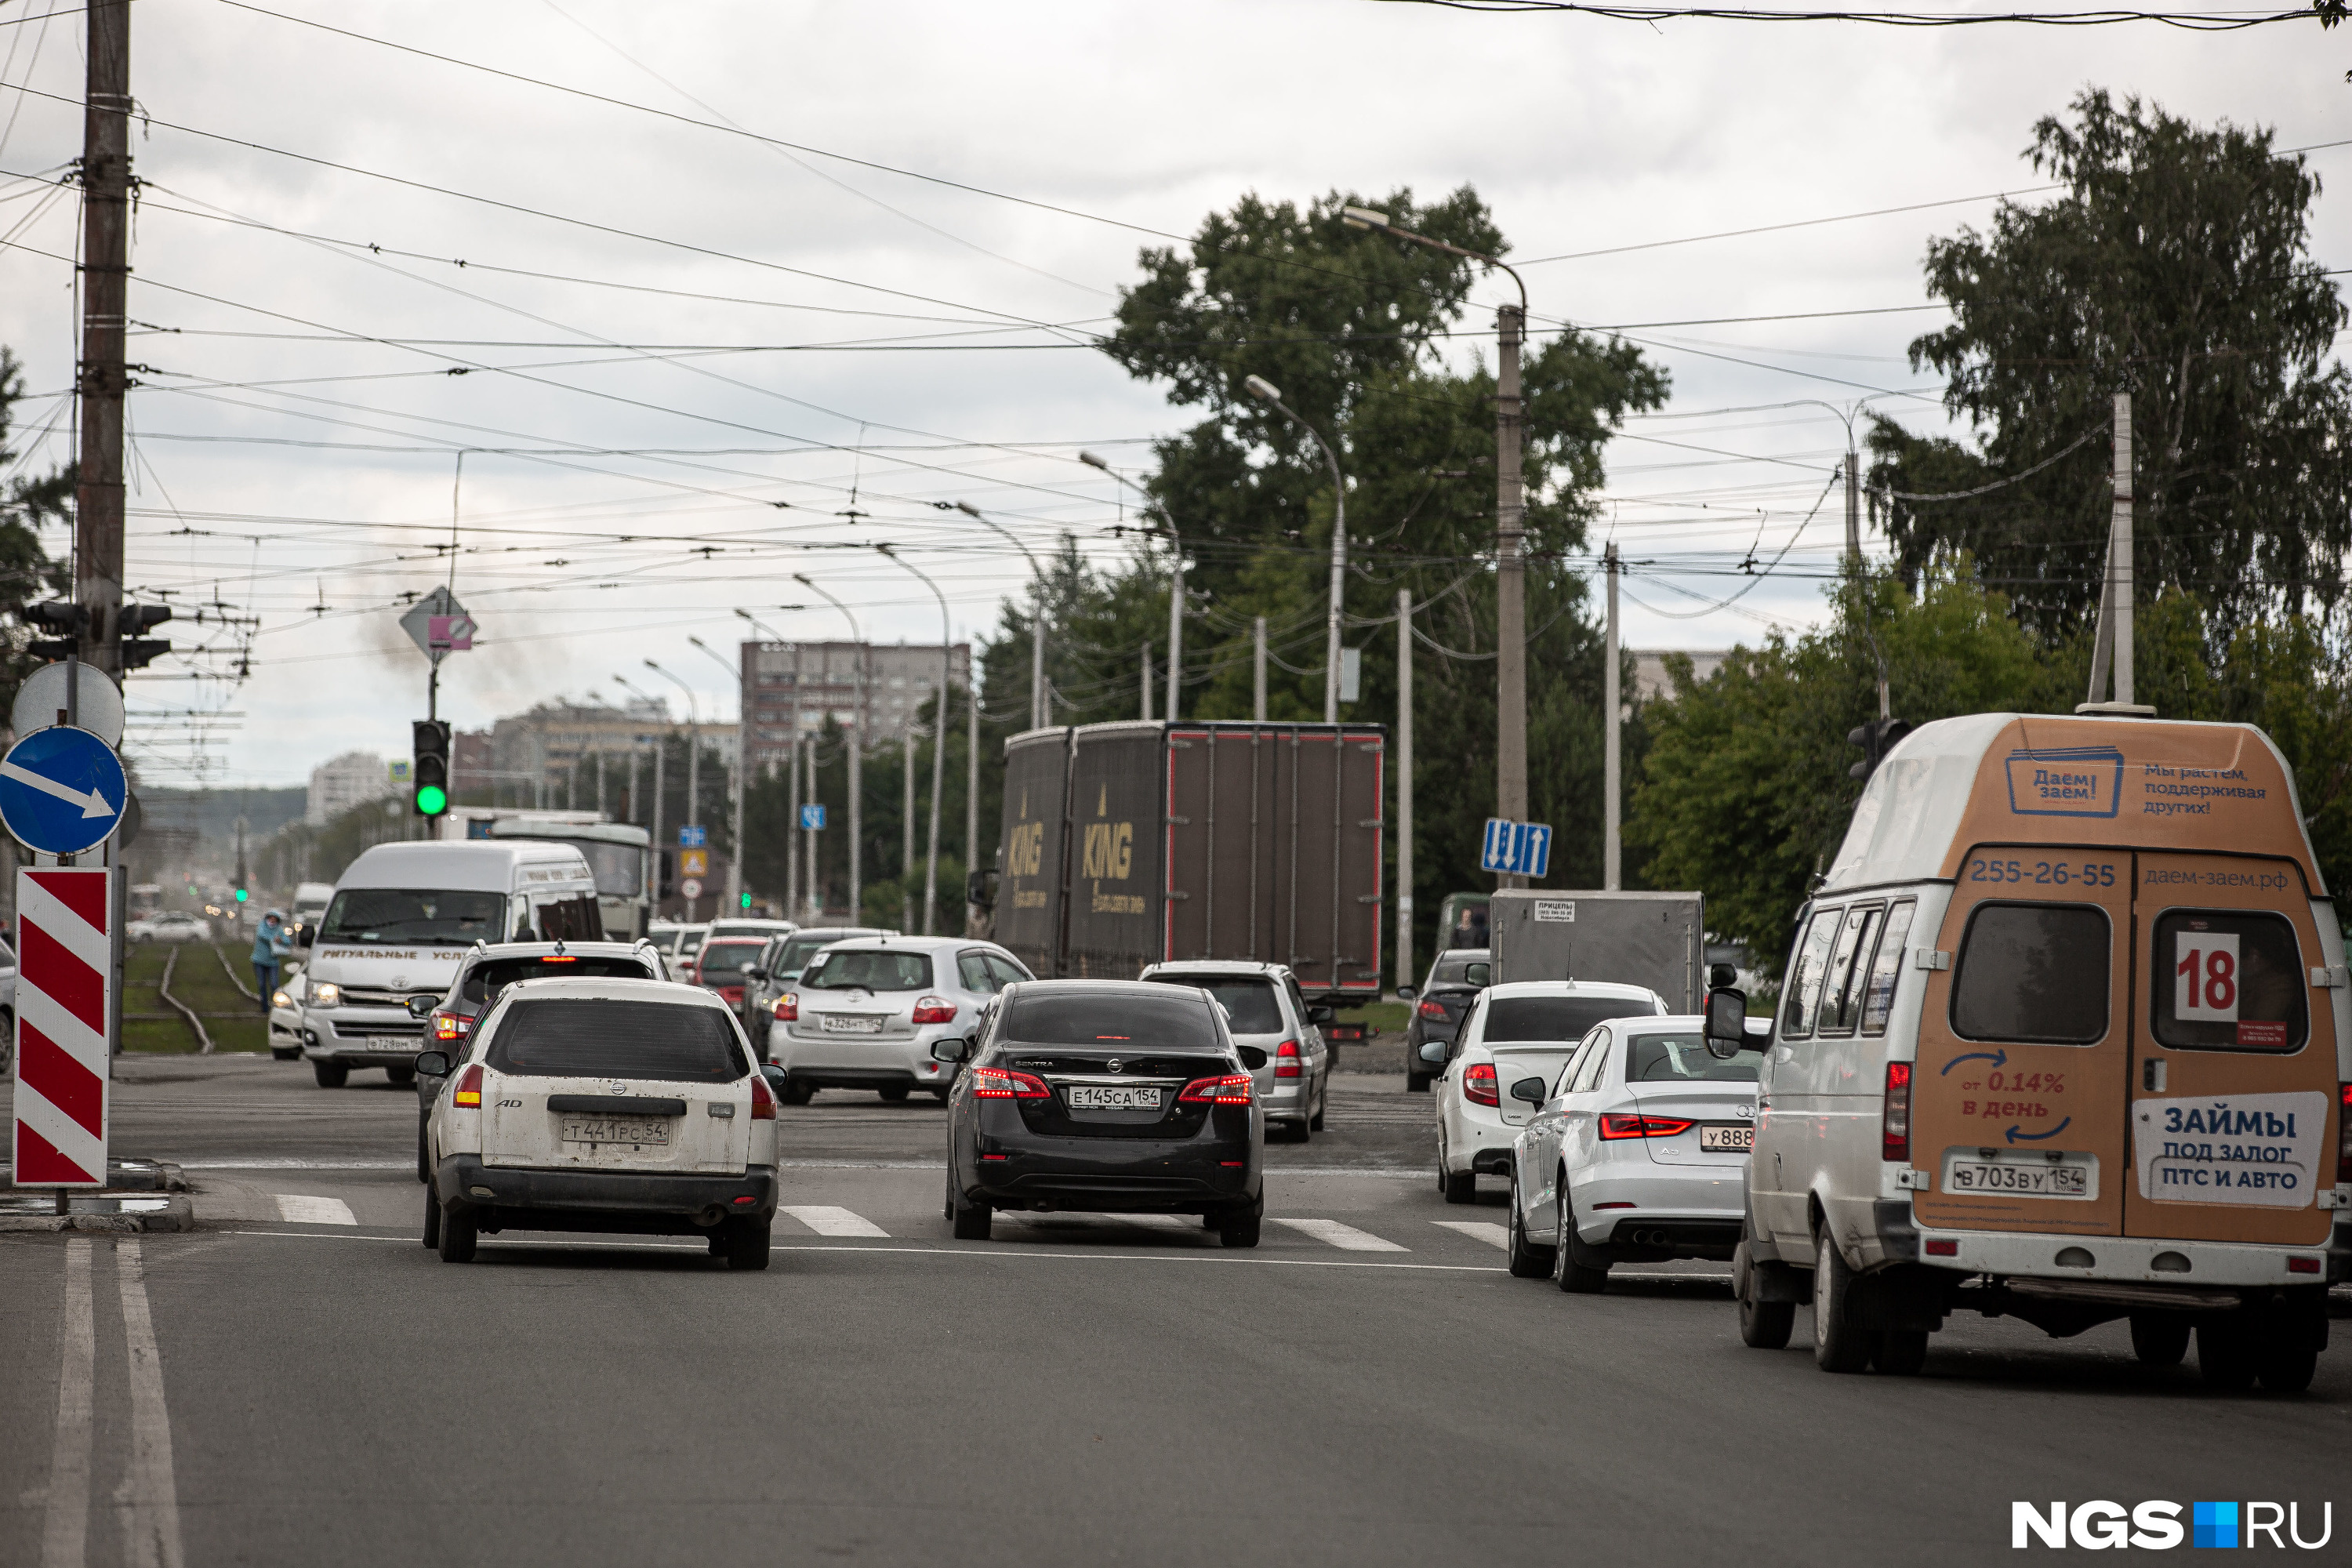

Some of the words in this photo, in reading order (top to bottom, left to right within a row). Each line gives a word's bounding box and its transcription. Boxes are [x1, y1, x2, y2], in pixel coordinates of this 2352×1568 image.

[2145, 782, 2266, 800] поддерживая
[2143, 800, 2211, 816] других!
[1007, 822, 1044, 878] KING
[1083, 822, 1133, 879] KING
[1971, 860, 2115, 887] 255-26-55
[2144, 869, 2288, 891] даем-заем.рф
[322, 949, 418, 960] РИТУАЛЬНЫЕ
[2178, 949, 2236, 1010] 18
[1962, 1081, 1981, 1091] от
[1987, 1072, 2065, 1093] 0.14%
[1134, 1089, 1158, 1101] 154
[1982, 1102, 2049, 1119] день
[2165, 1103, 2297, 1138] ЗАЙМЫ
[646, 1123, 662, 1137] 54
[2164, 1142, 2212, 1163] ПОД
[2220, 1144, 2292, 1163] ЗАЛОГ
[2049, 1169, 2080, 1185] 154
[2163, 1167, 2209, 1185] ПТС
[2215, 1171, 2230, 1187] И
[2238, 1171, 2297, 1190] АВТО
